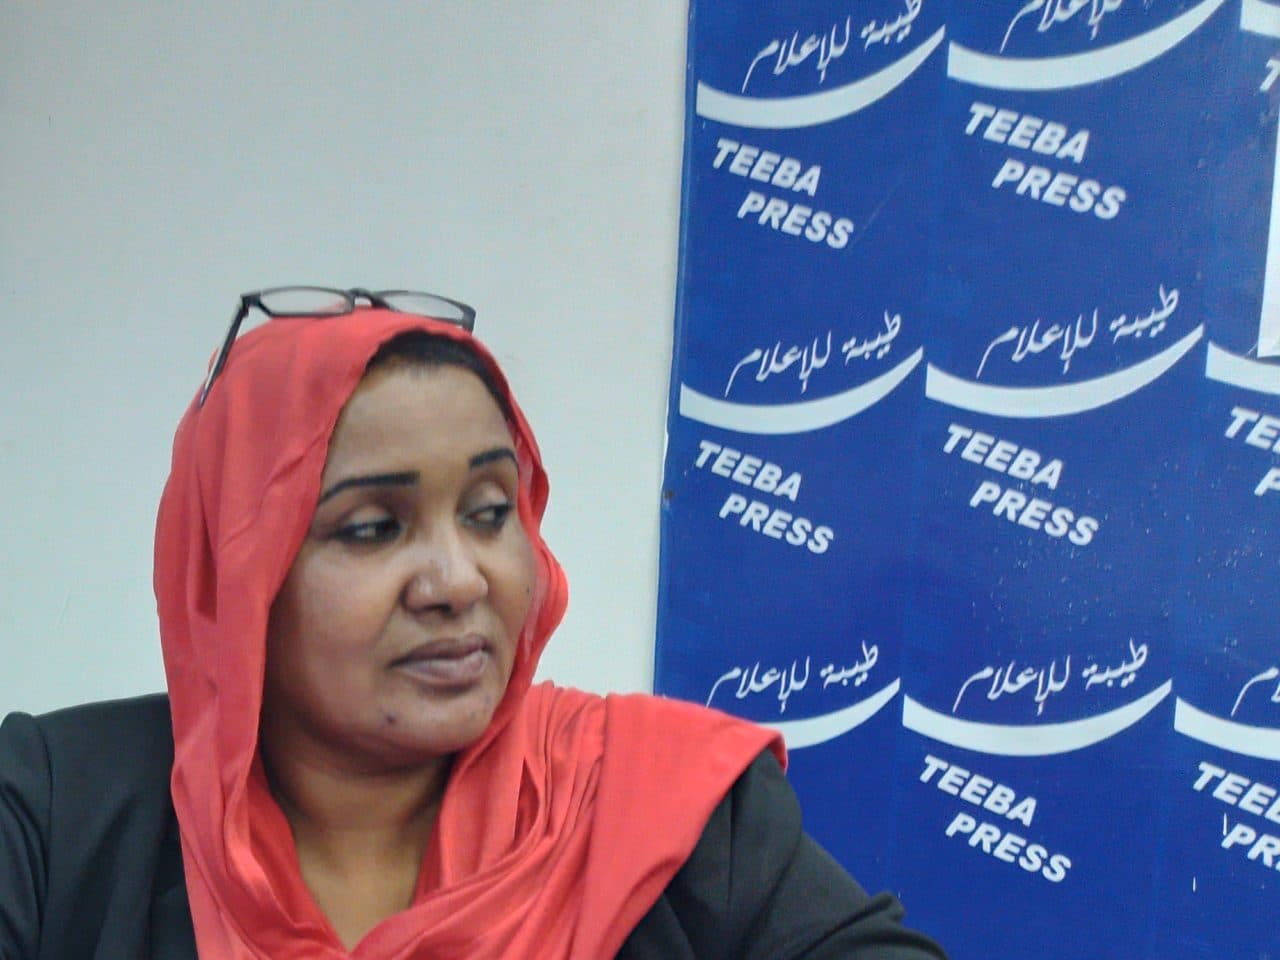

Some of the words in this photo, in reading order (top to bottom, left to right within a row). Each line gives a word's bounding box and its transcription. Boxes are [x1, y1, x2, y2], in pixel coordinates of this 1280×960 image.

[741, 15, 850, 93] للإعلام
[964, 102, 1089, 162] TEEBA
[712, 138, 821, 196] TEEBA
[992, 159, 1126, 220] PRESS
[737, 191, 854, 249] PRESS
[841, 309, 903, 356] طيبة
[1108, 282, 1180, 342] طيبة
[725, 331, 831, 396] للإعلام
[976, 308, 1100, 378] للإعلام
[695, 440, 803, 501] TEEBA
[942, 423, 1064, 489] TEEBA
[719, 493, 834, 555] PRESS
[971, 481, 1099, 546] PRESS
[707, 656, 811, 714] للإعلام
[819, 639, 879, 689] طيبة
[953, 656, 1071, 716] للإعلام
[1082, 639, 1149, 689] طيبة
[920, 755, 1037, 827] TEEBA
[946, 812, 1071, 882] PRESS
